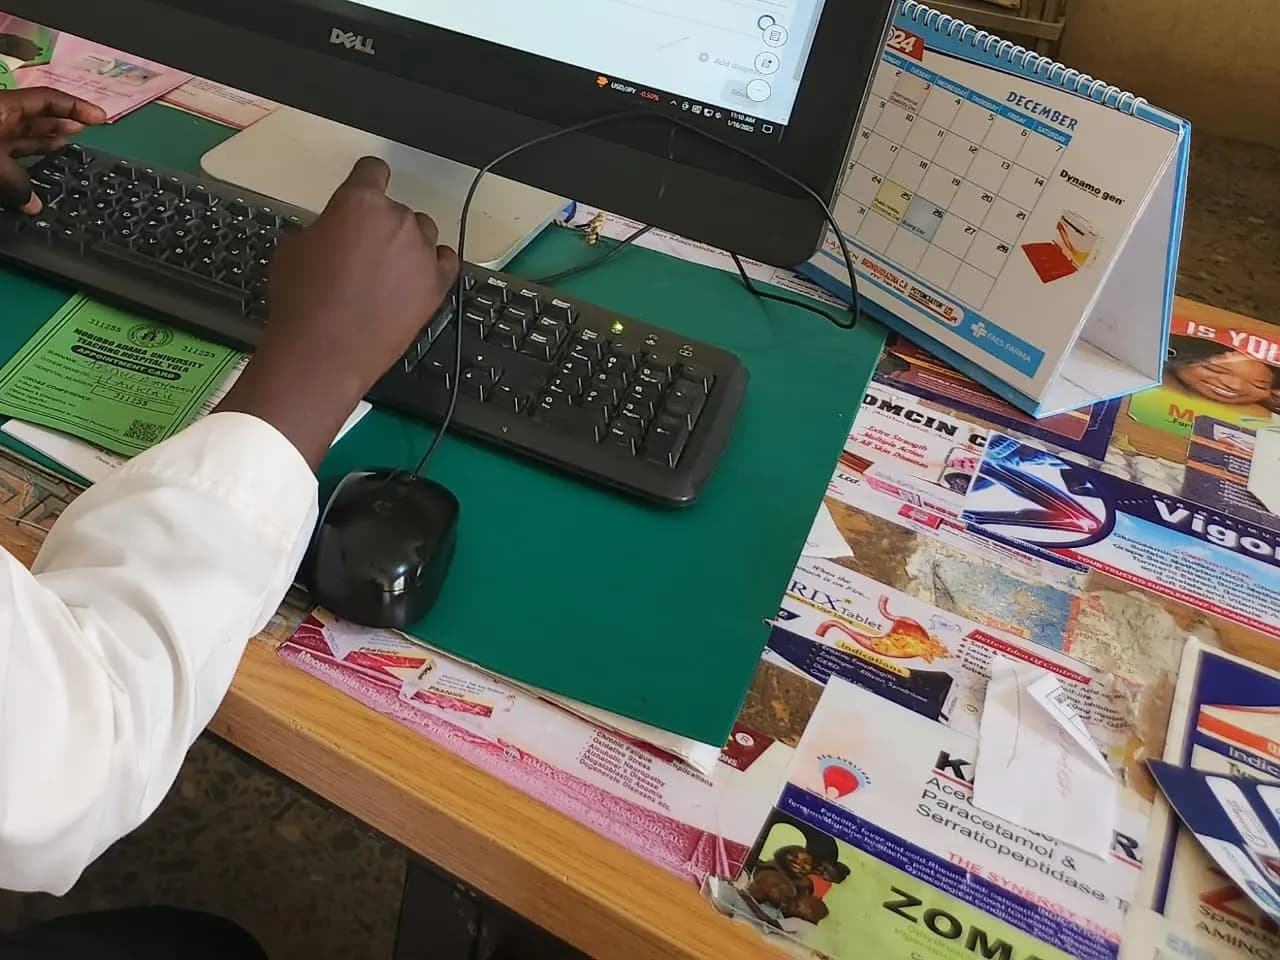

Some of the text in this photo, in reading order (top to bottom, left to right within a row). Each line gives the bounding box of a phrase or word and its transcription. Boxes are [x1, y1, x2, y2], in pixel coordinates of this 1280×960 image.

[329, 27, 375, 55] DELL
[1007, 92, 1078, 131] DECEMBER
[906, 113, 913, 122] 10
[860, 131, 870, 140] 16
[889, 145, 898, 153] 17
[968, 145, 978, 154] 12
[919, 161, 928, 169] 18
[1001, 161, 1011, 170] 13
[871, 175, 882, 184] 24
[952, 178, 960, 186] 19
[1034, 178, 1045, 187] 14
[901, 192, 912, 201] 25
[981, 193, 993, 203] 20
[933, 208, 944, 219] 26
[1015, 211, 1027, 221] 21
[964, 226, 977, 236] 27
[996, 243, 1009, 254] 28
[1186, 320, 1216, 339] IS
[77, 337, 190, 373] TEACHING HOSPITAL YOLA
[116, 342, 148, 356] ADAMA
[149, 351, 205, 369] UNIVERSITY
[76, 346, 148, 374] APPOINTMENT
[148, 367, 176, 379] CARD
[868, 426, 890, 437] Extra
[838, 575, 852, 584] the
[790, 580, 884, 631] RIX Tablet
[841, 642, 903, 674] Indications
[816, 657, 840, 671] GERD
[596, 731, 653, 764] Chronic Fatigue
[588, 743, 622, 765] Alcoholic
[592, 737, 651, 771] Oxidative Stress
[672, 761, 714, 788] mplications
[921, 789, 1055, 860] Paracetamol
[1061, 856, 1078, 872] &
[916, 804, 1106, 901] Serratiopeptidase
[947, 851, 983, 875] THE
